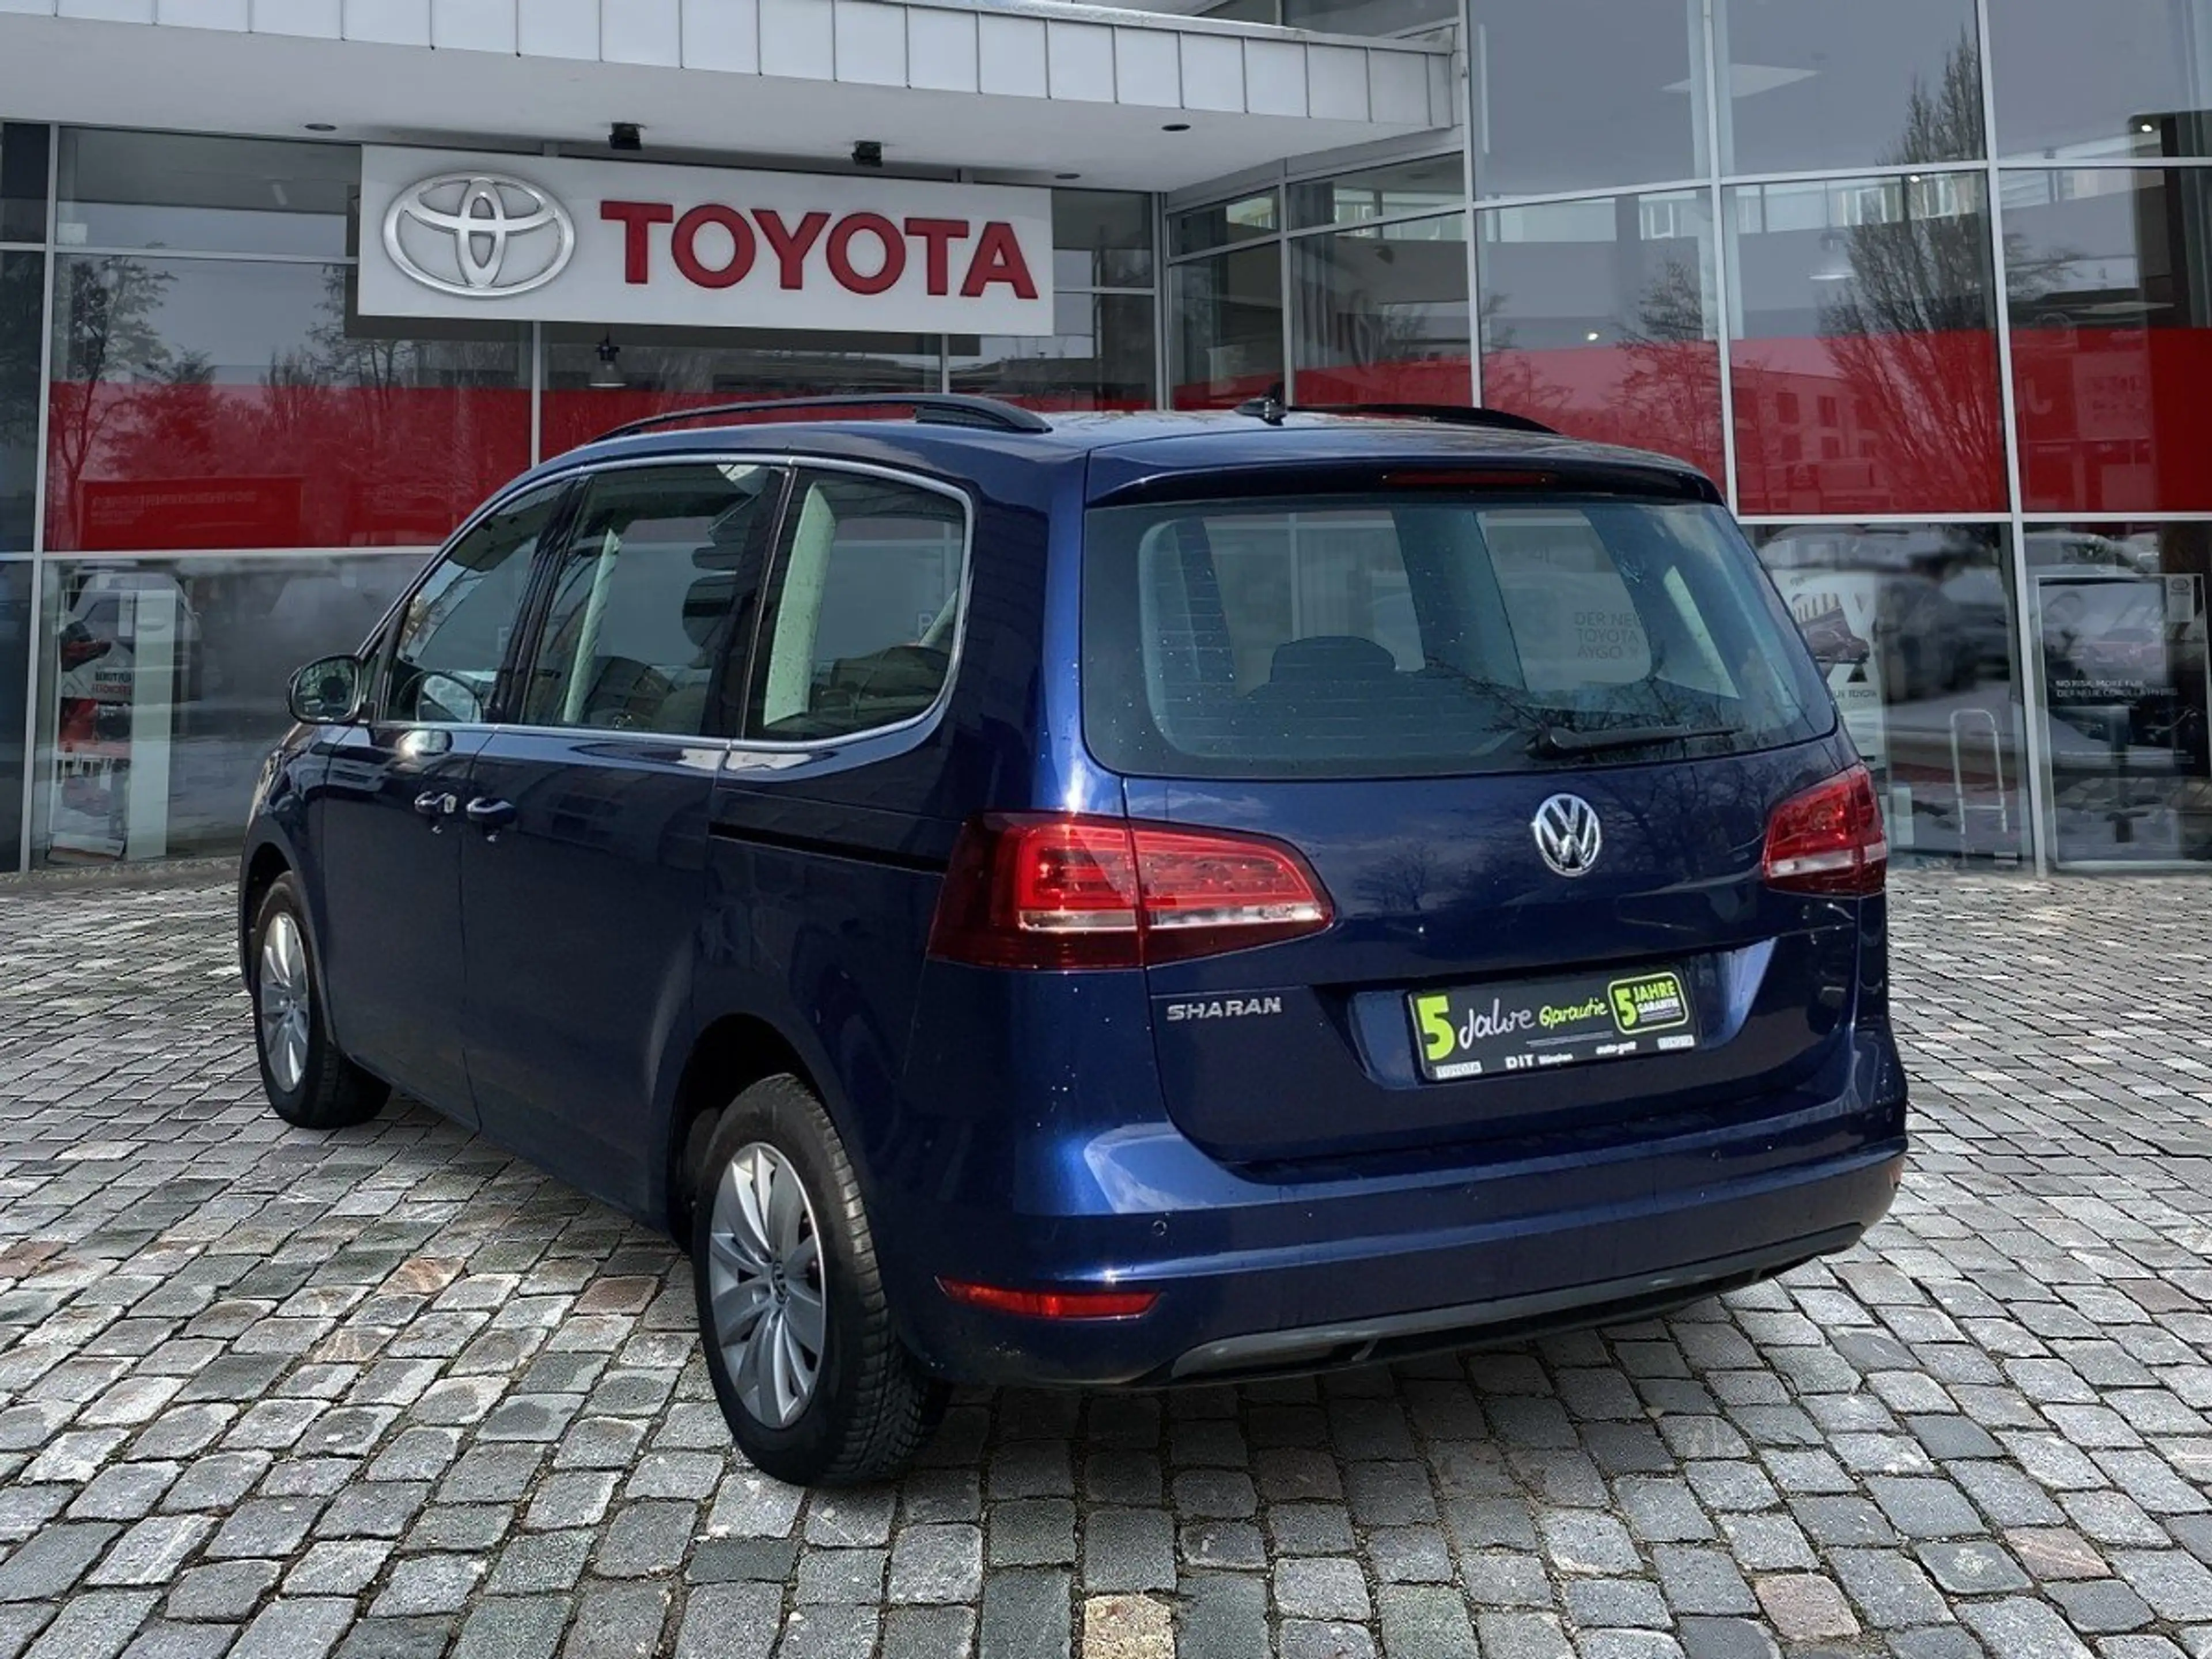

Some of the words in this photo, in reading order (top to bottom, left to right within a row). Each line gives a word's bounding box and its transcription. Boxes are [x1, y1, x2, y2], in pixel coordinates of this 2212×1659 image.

[600, 200, 1039, 299] TOYOTA
[1574, 612, 1606, 626] DER
[1611, 612, 1641, 627] NEU
[1575, 628, 1640, 643] TOYOTA
[1577, 645, 1623, 659] AYGO
[1166, 997, 1282, 1021] SHARAN
[1614, 988, 1638, 1027] 5
[1633, 980, 1677, 1002] JAHRE
[1417, 995, 1455, 1060] 5
